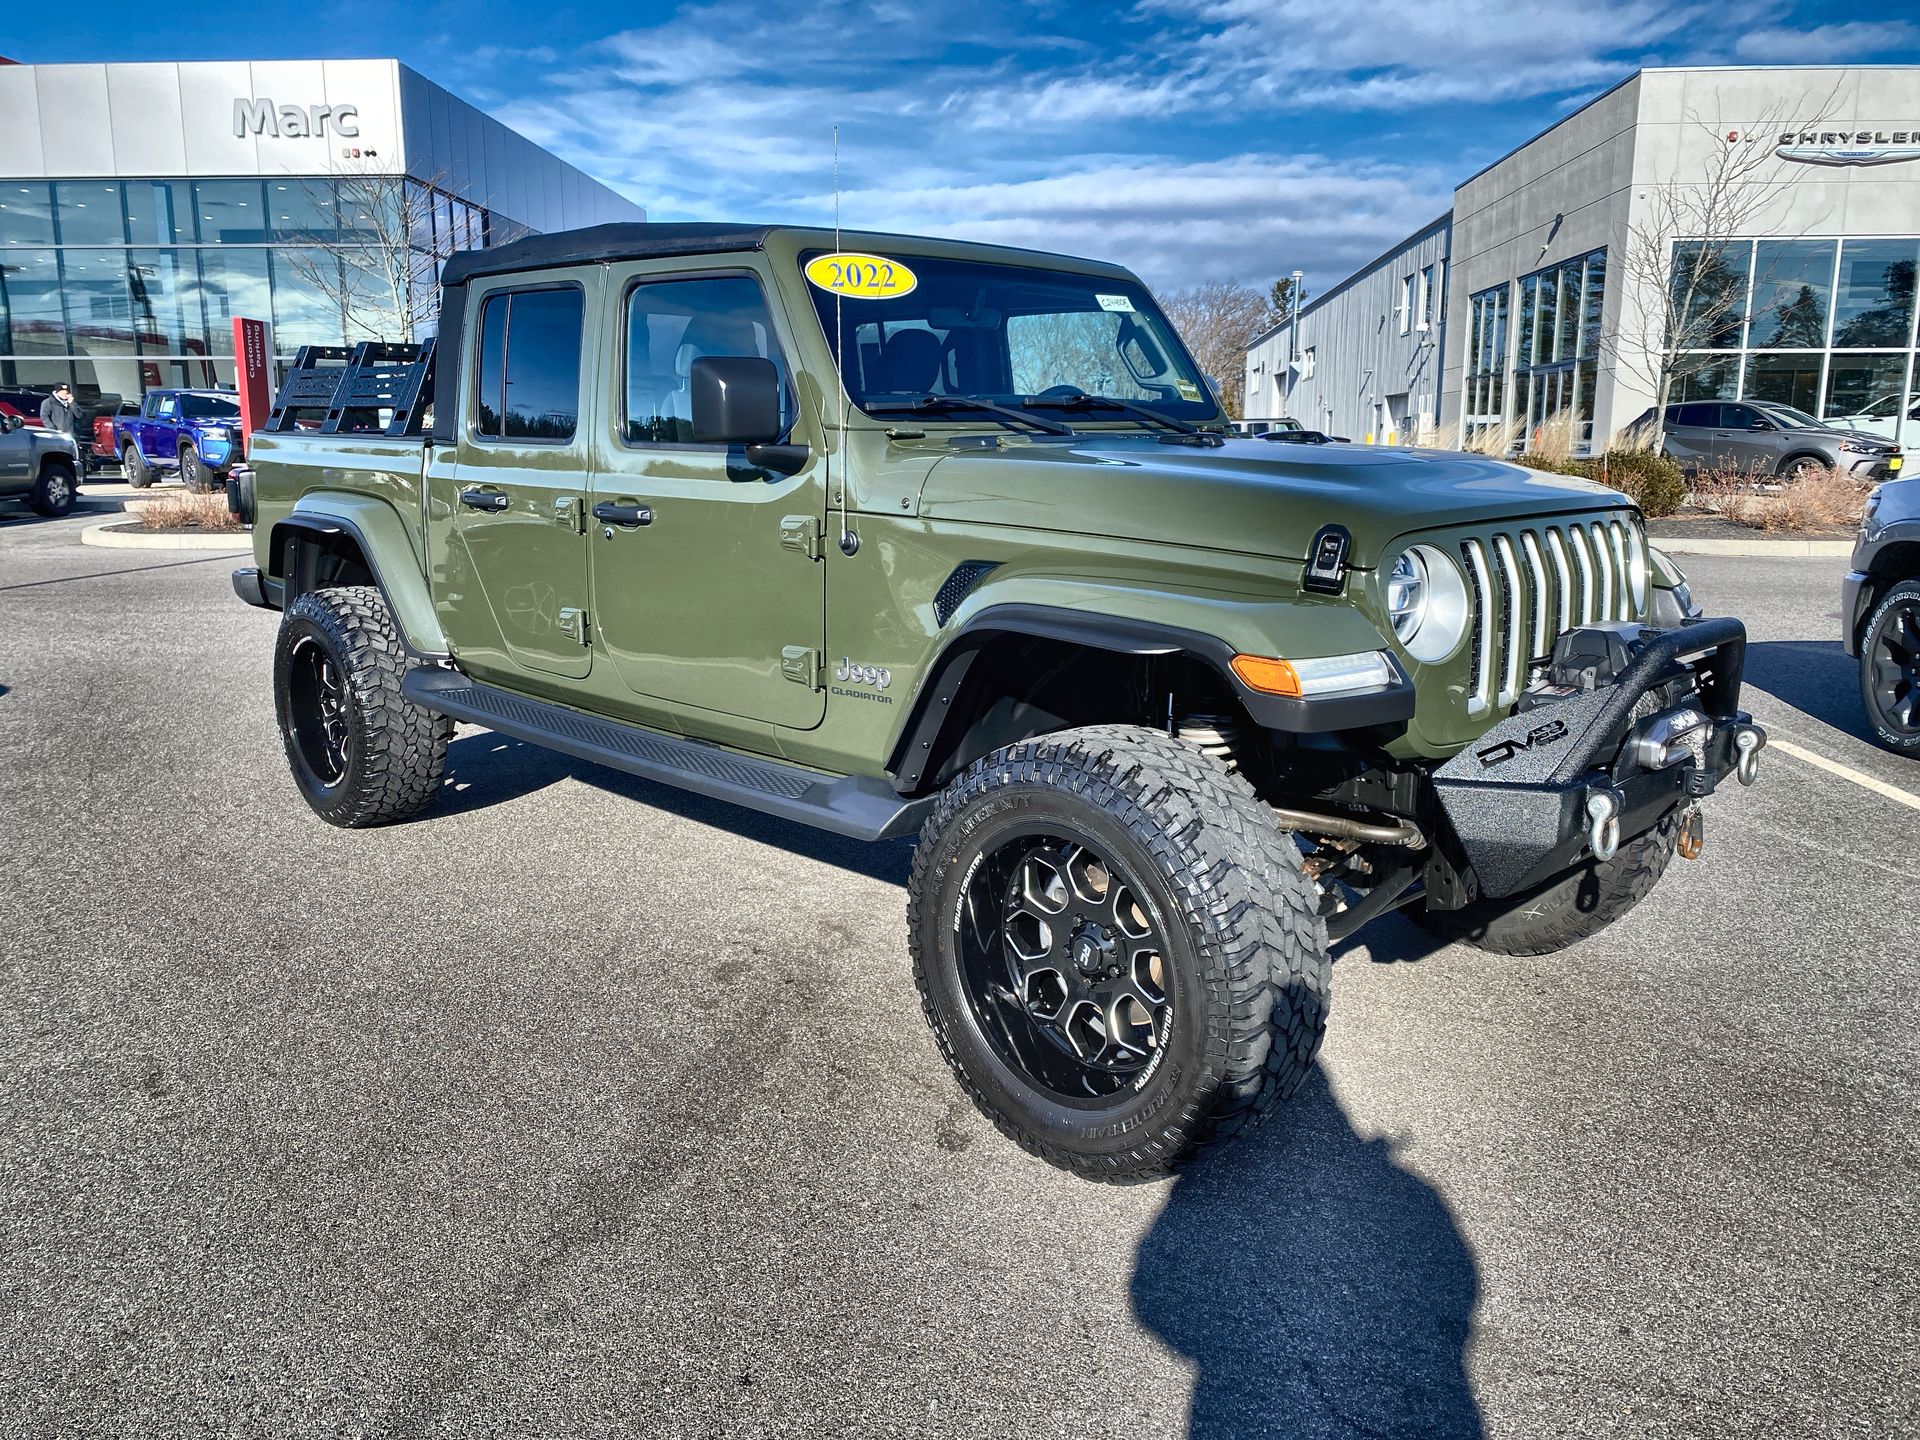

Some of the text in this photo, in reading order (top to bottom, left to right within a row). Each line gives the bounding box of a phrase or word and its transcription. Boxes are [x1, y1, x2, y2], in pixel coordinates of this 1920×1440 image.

[233, 98, 359, 138] Marc
[828, 263, 896, 288] 2022
[246, 324, 255, 378] Customer
[254, 324, 262, 367] Parking
[836, 656, 892, 692] Jeep
[831, 686, 893, 704] GLADIATOR
[953, 850, 983, 933] ROUGH COUNTRY
[1134, 1005, 1173, 1092] ROUGH COUNTRY
